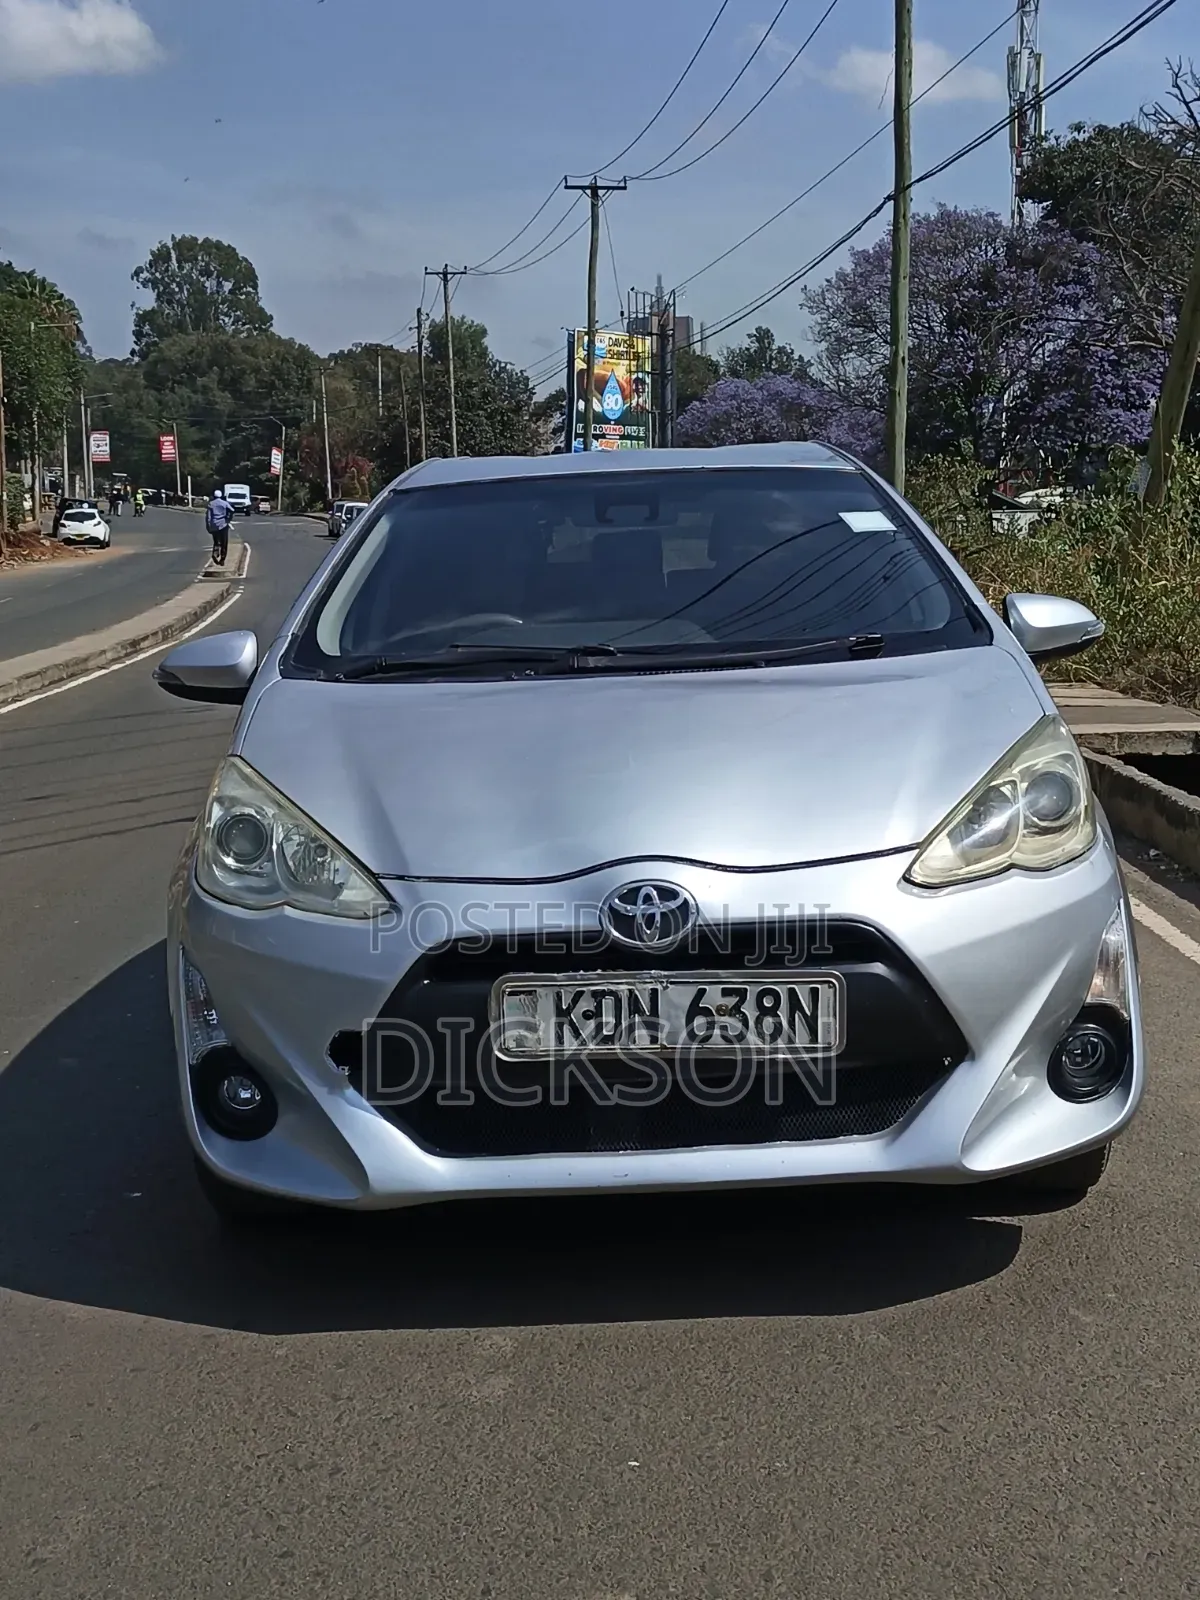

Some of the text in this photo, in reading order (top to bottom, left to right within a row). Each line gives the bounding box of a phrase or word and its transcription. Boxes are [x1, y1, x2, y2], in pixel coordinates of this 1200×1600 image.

[608, 337, 629, 349] DAVIS
[603, 393, 622, 410] 80
[555, 987, 660, 1047] KDN
[684, 985, 823, 1047] 638N
